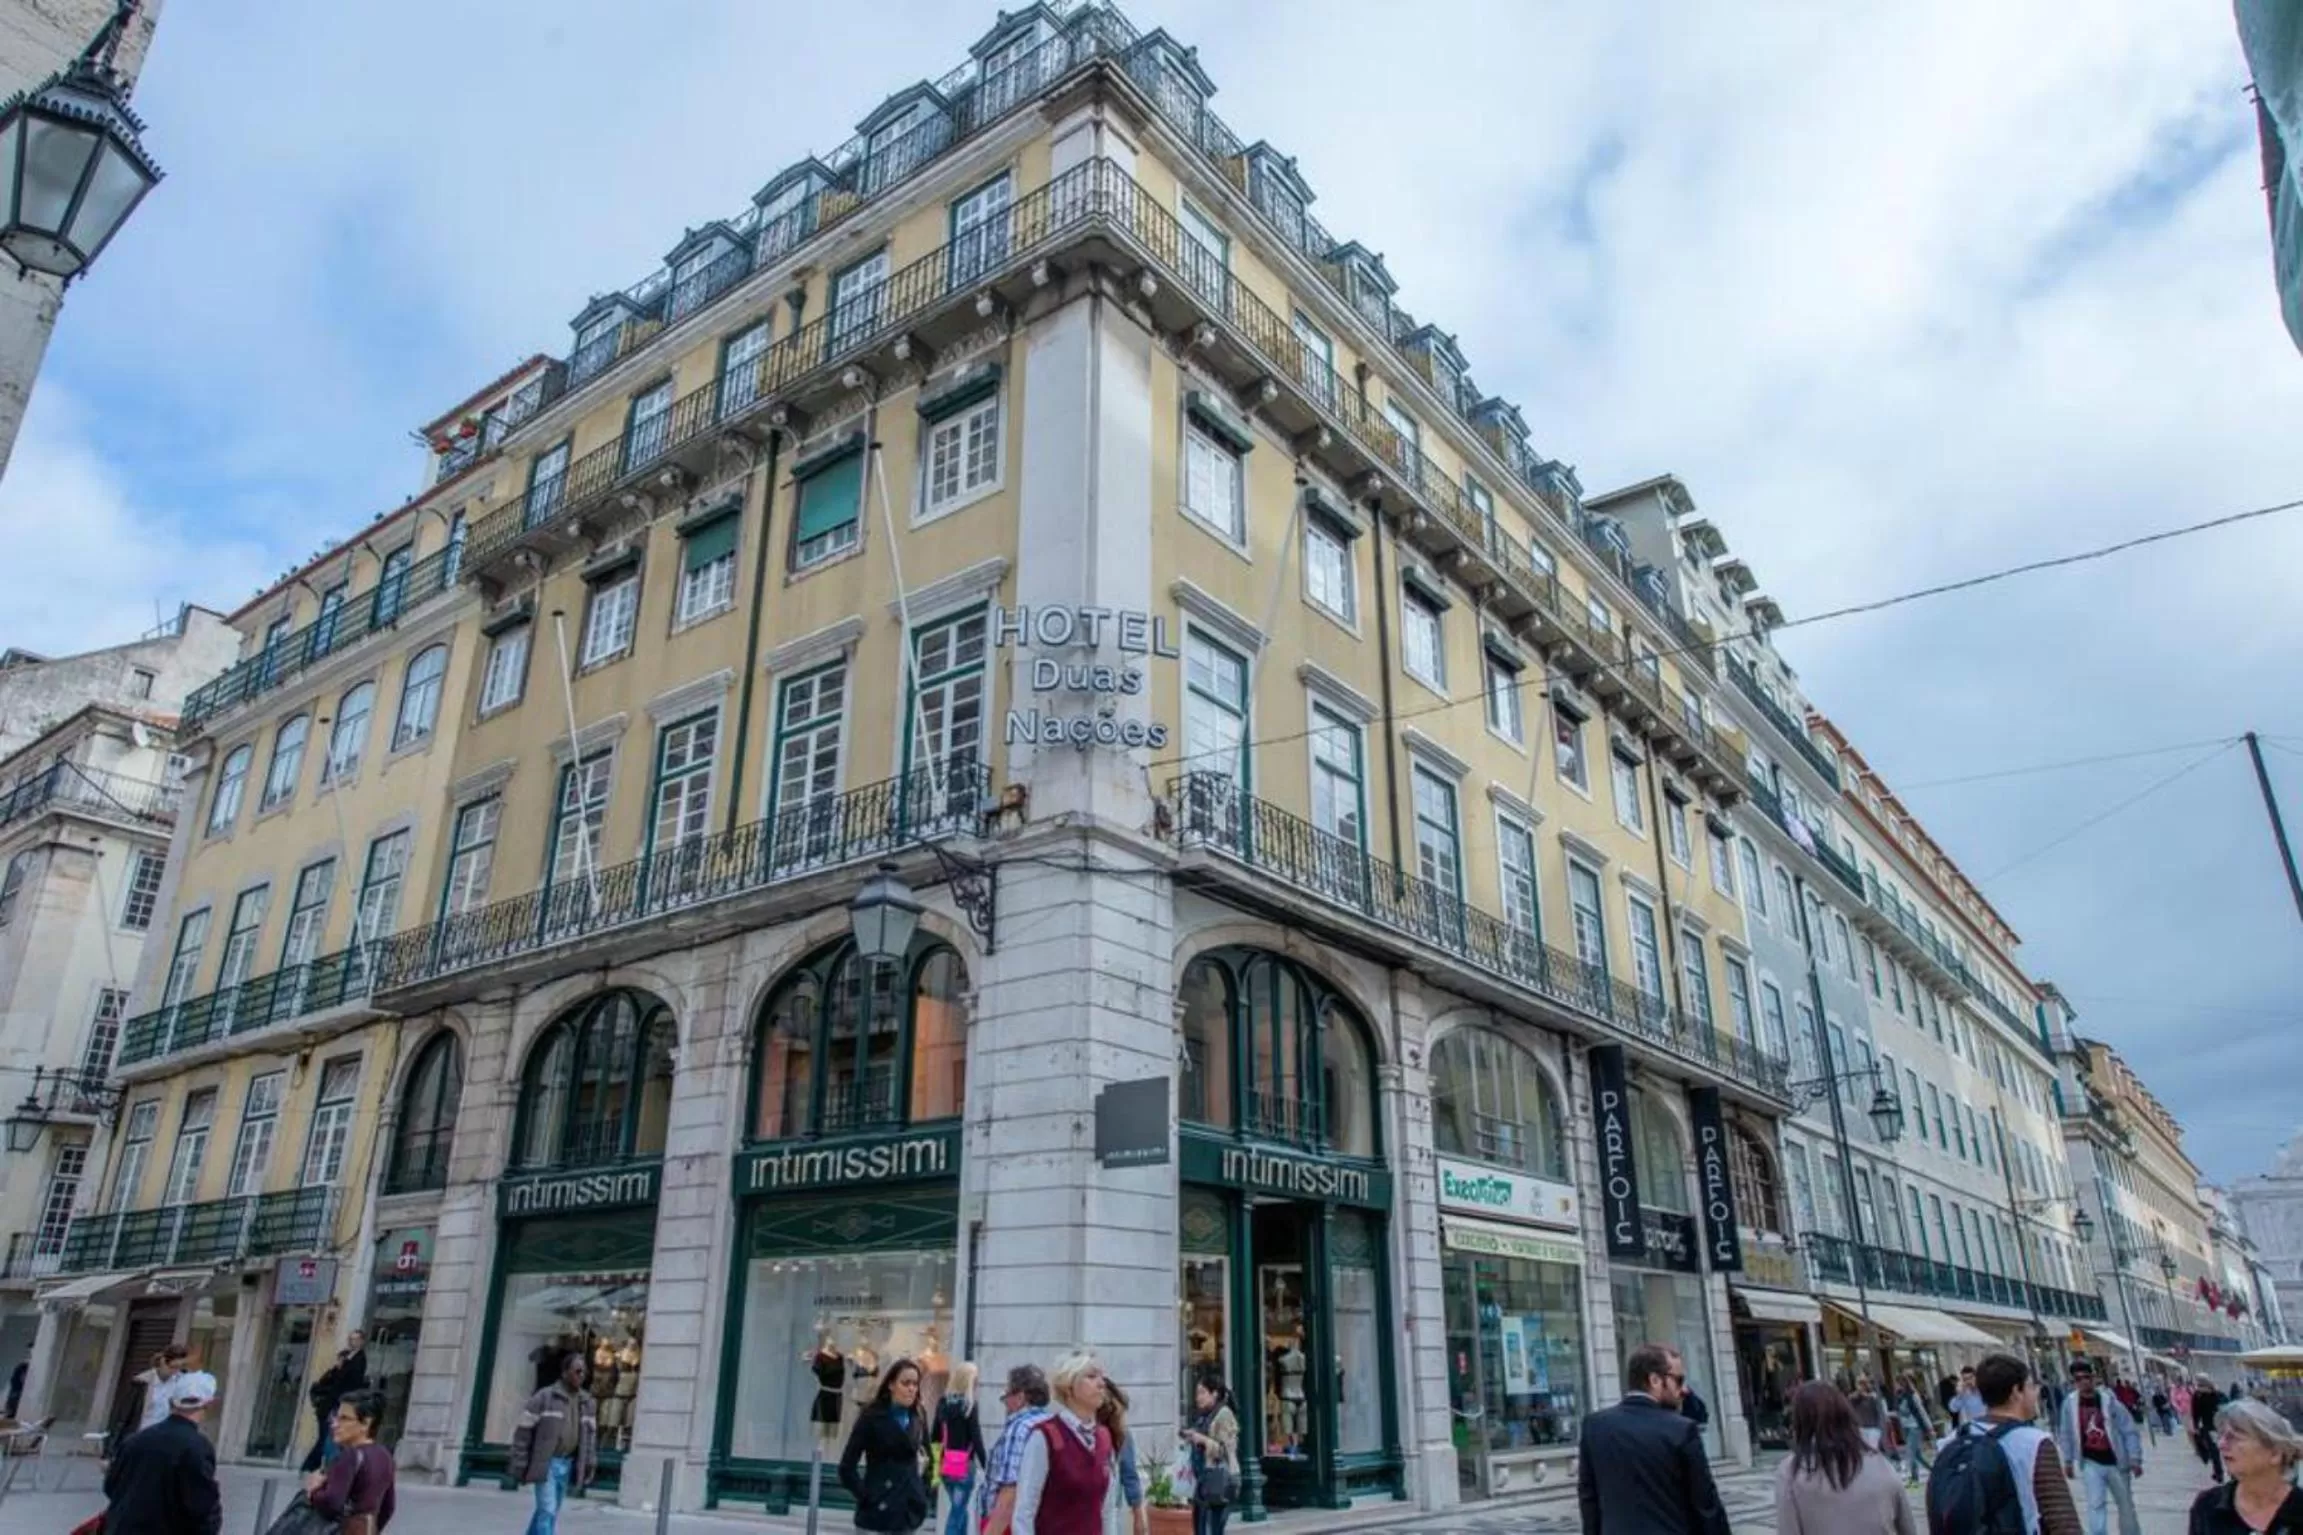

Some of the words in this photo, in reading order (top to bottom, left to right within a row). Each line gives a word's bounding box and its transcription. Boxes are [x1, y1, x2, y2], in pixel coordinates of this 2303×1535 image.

[994, 604, 1180, 659] HOTEL
[1032, 657, 1145, 695] Duas
[1004, 701, 1169, 754] Nações
[749, 1138, 949, 1189] intimissimi
[1221, 1146, 1370, 1201] intimissimi
[1602, 1091, 1634, 1245] PARFOIS
[507, 1171, 651, 1214] intimissimi
[1702, 1127, 1733, 1262] PARFOIS
